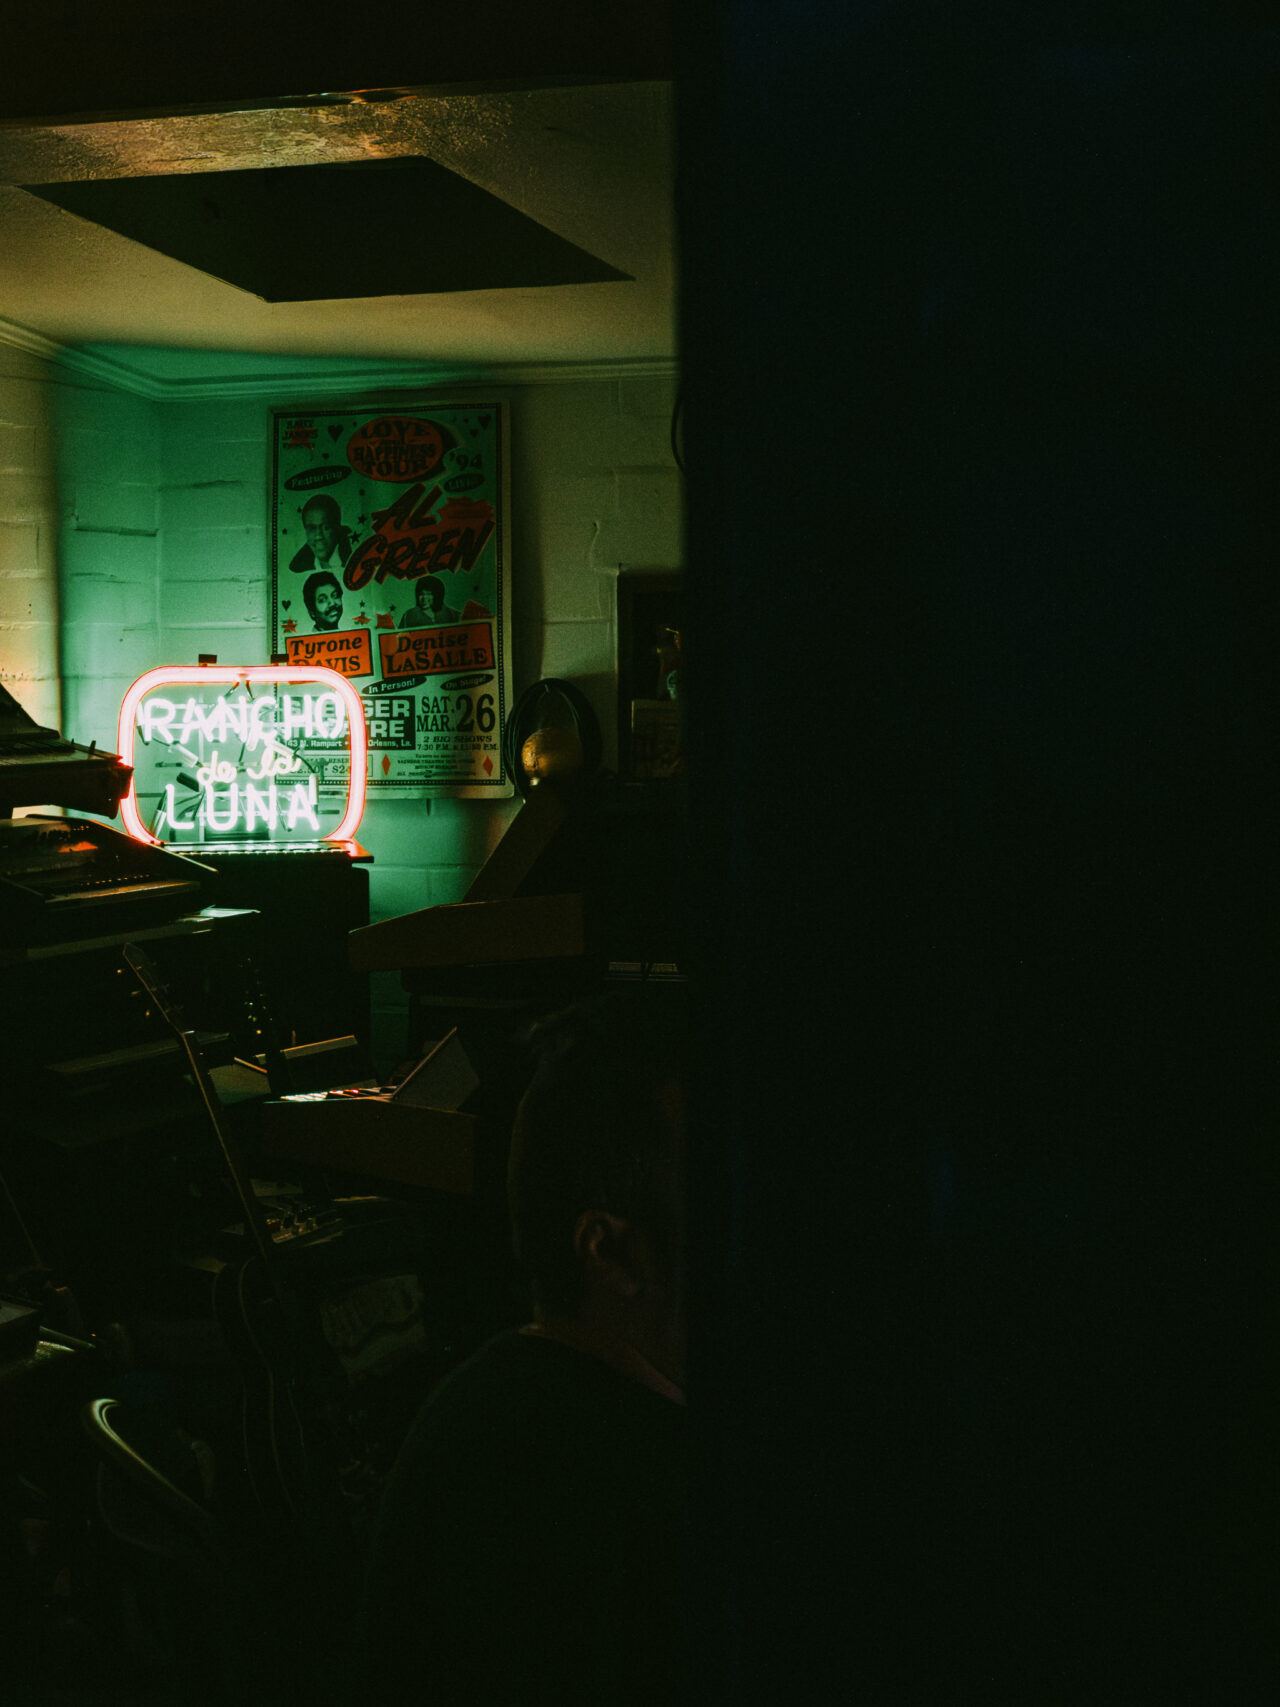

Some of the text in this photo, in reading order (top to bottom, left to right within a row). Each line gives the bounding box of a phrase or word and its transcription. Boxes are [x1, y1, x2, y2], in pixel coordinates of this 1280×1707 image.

[360, 421, 431, 442] LOVE
[360, 458, 428, 476] TOUR
[449, 452, 483, 470] '94
[371, 482, 444, 533] AL
[343, 520, 496, 591] GREEN
[289, 635, 363, 660] Tyrone
[397, 631, 469, 654] Denise
[368, 678, 417, 694] In Person!
[421, 695, 455, 714] SAT.
[455, 693, 496, 733] 26
[144, 692, 346, 743] RANCHO
[416, 714, 455, 732] MAR.
[311, 739, 343, 749] Rampart
[196, 747, 303, 786] de la
[165, 782, 321, 832] LUNA
